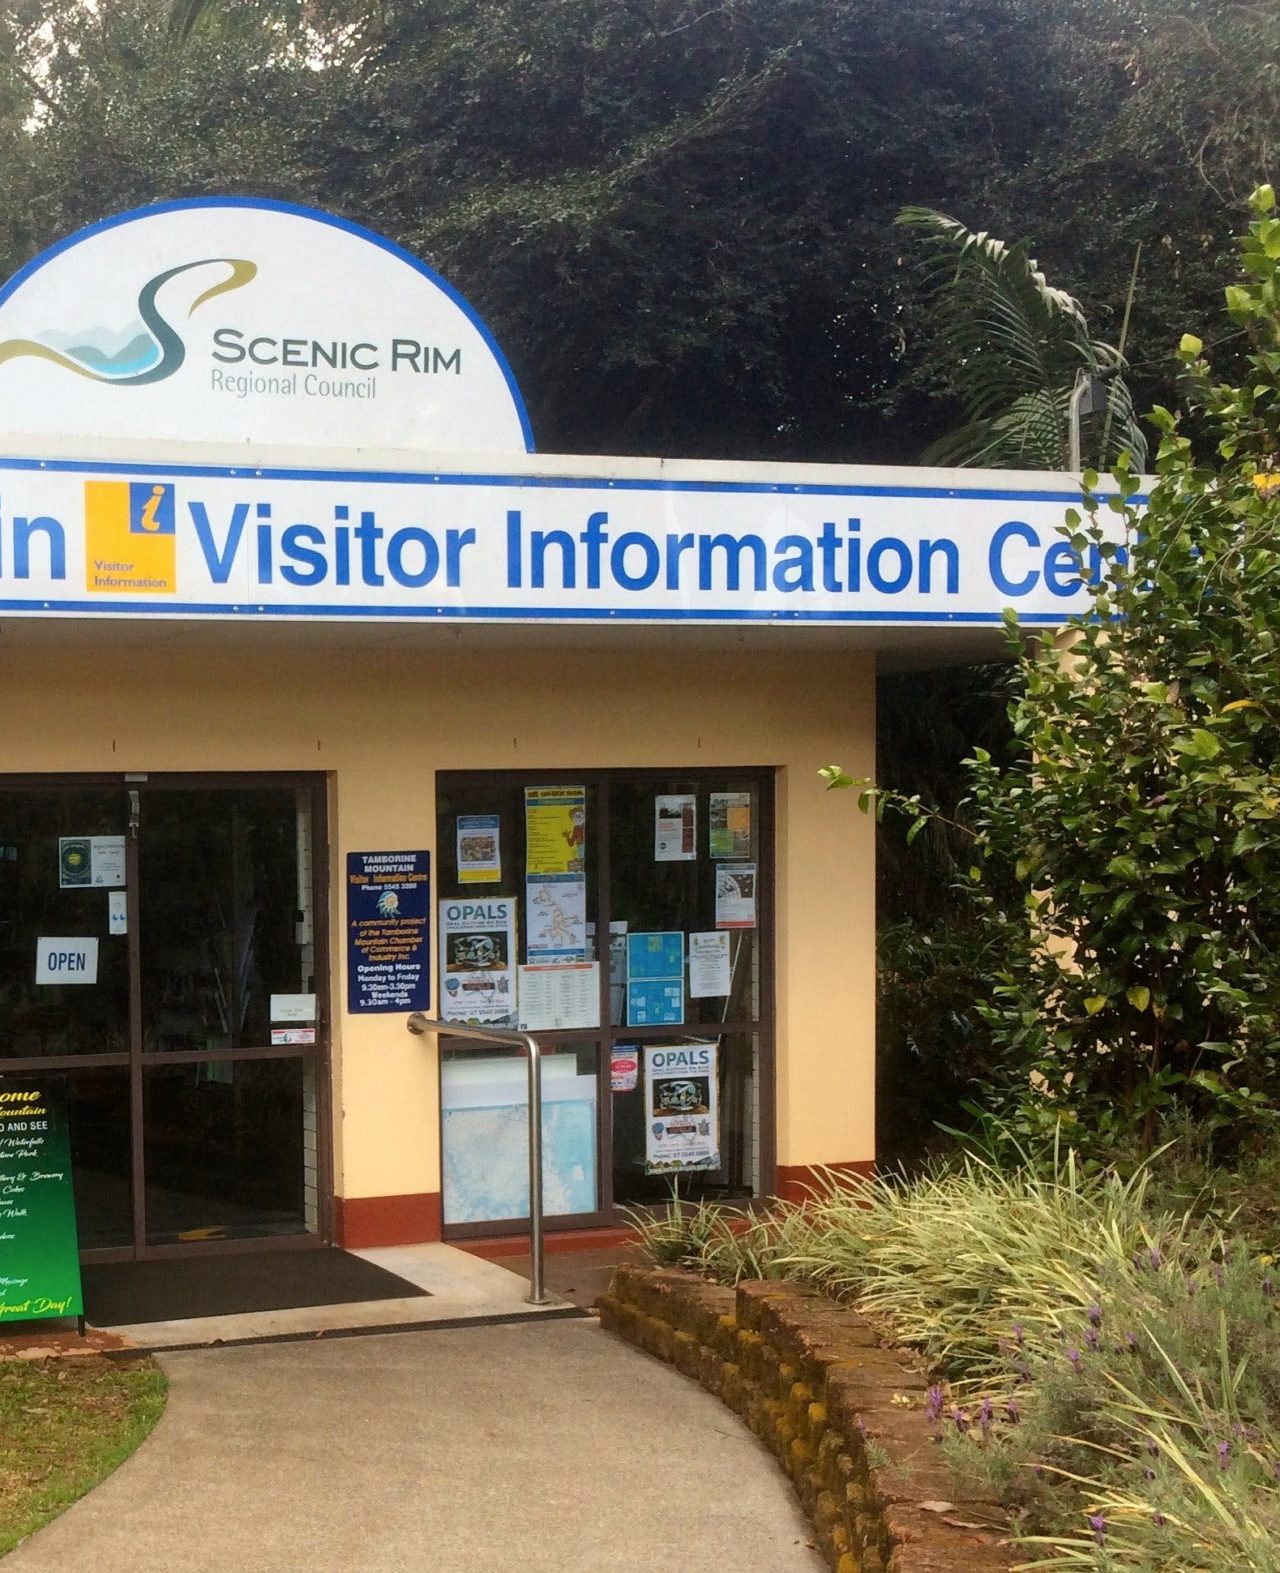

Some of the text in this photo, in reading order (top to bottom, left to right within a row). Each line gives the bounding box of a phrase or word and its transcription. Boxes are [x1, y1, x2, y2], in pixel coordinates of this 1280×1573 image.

[211, 369, 376, 398] Regional Council
[187, 501, 476, 588] Visitor
[506, 510, 960, 594] Information
[94, 560, 135, 572] Visitor
[94, 575, 168, 588] Information
[361, 855, 417, 864] TAMBORINE
[364, 864, 414, 873] MOUNTAIN
[446, 904, 508, 920] OPALS
[358, 919, 400, 927] community
[400, 917, 426, 926] project
[353, 938, 388, 946] Mountain
[369, 945, 411, 953] Commerce
[48, 952, 86, 971] OPEN
[357, 963, 421, 973] Opening Hours
[357, 974, 387, 982] Monday
[396, 973, 420, 981] Friday
[371, 990, 409, 999] Weekends
[359, 998, 389, 1007] 9.30am
[394, 998, 412, 1006] 4pm
[651, 1050, 710, 1067] OPALS
[7, 1122, 28, 1132] AND
[30, 1121, 48, 1130] SEE
[15, 1149, 38, 1158] Park
[28, 1171, 64, 1181] Brewery
[2, 1185, 26, 1194] Cakes
[2, 1208, 28, 1217] Walk
[32, 1296, 72, 1314] Day!
